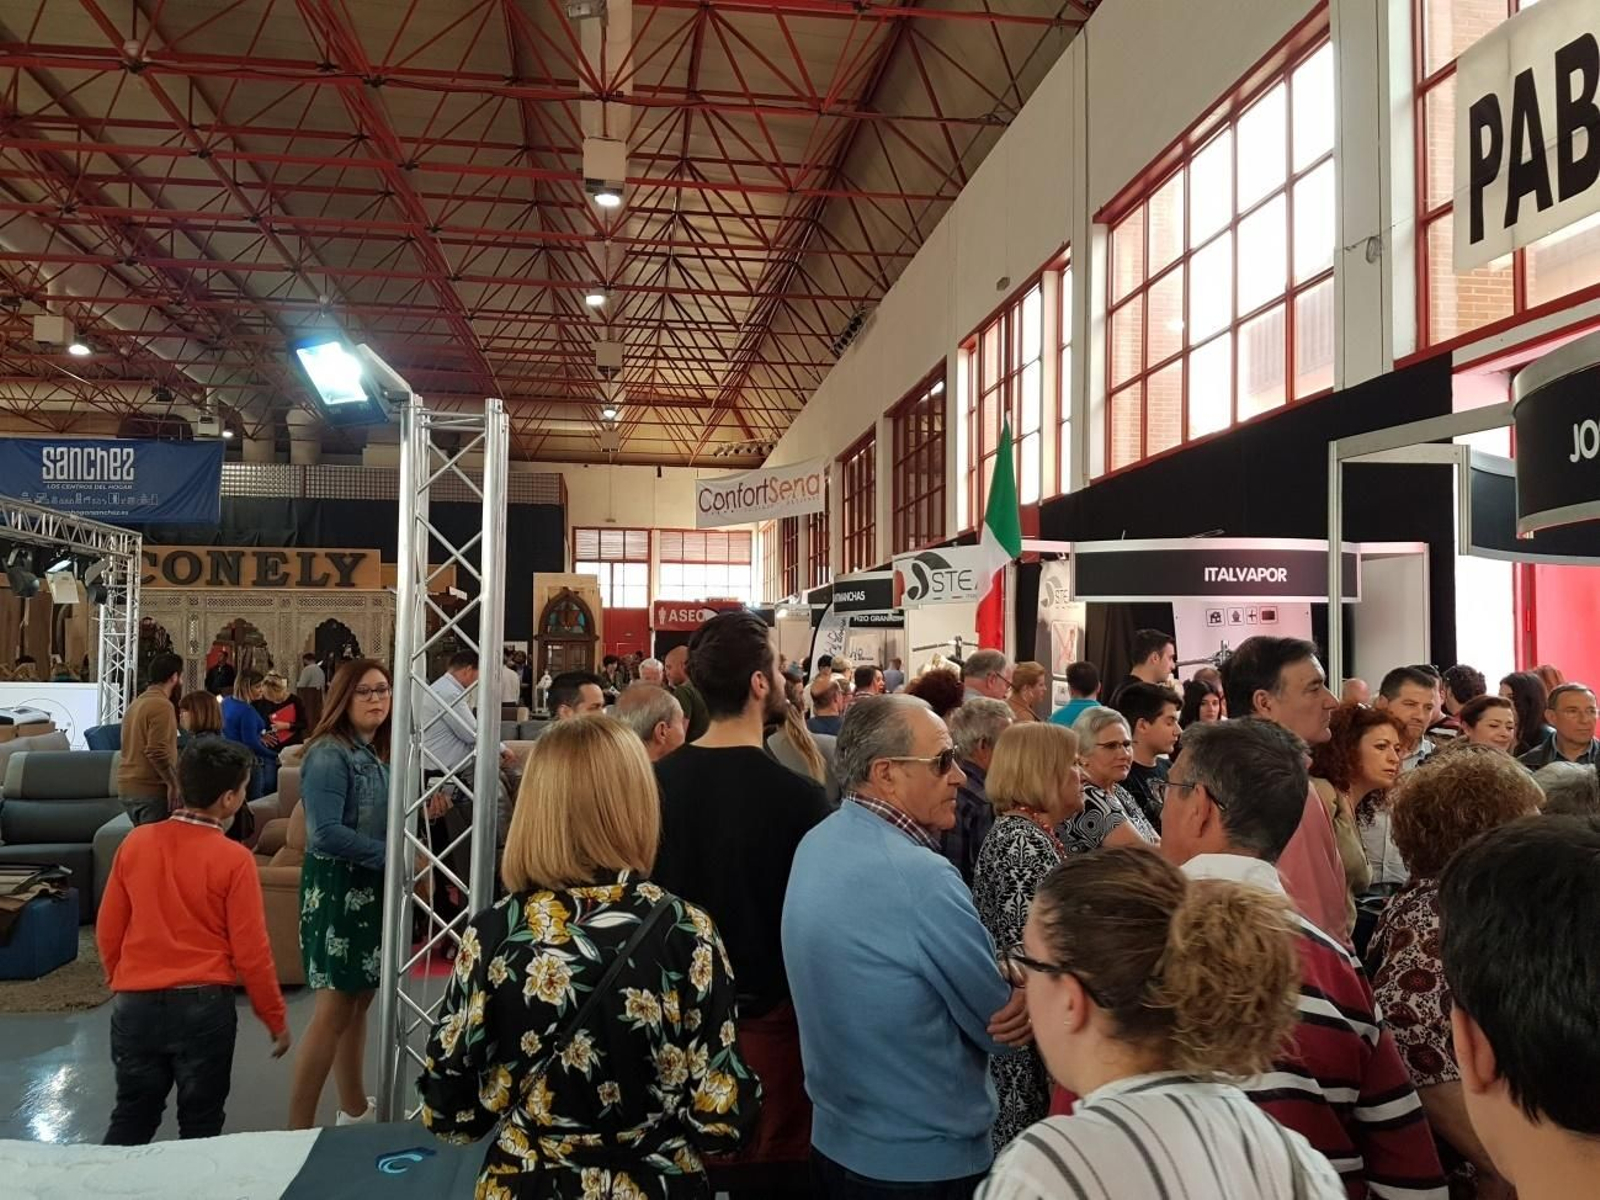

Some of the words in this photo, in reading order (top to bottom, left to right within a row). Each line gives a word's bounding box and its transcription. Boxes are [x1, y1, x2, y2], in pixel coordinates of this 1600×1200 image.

[1469, 32, 1600, 245] PAB
[1569, 419, 1600, 463] JO
[698, 473, 820, 513] ConfortSena
[1204, 567, 1288, 583] ITALVAPOR
